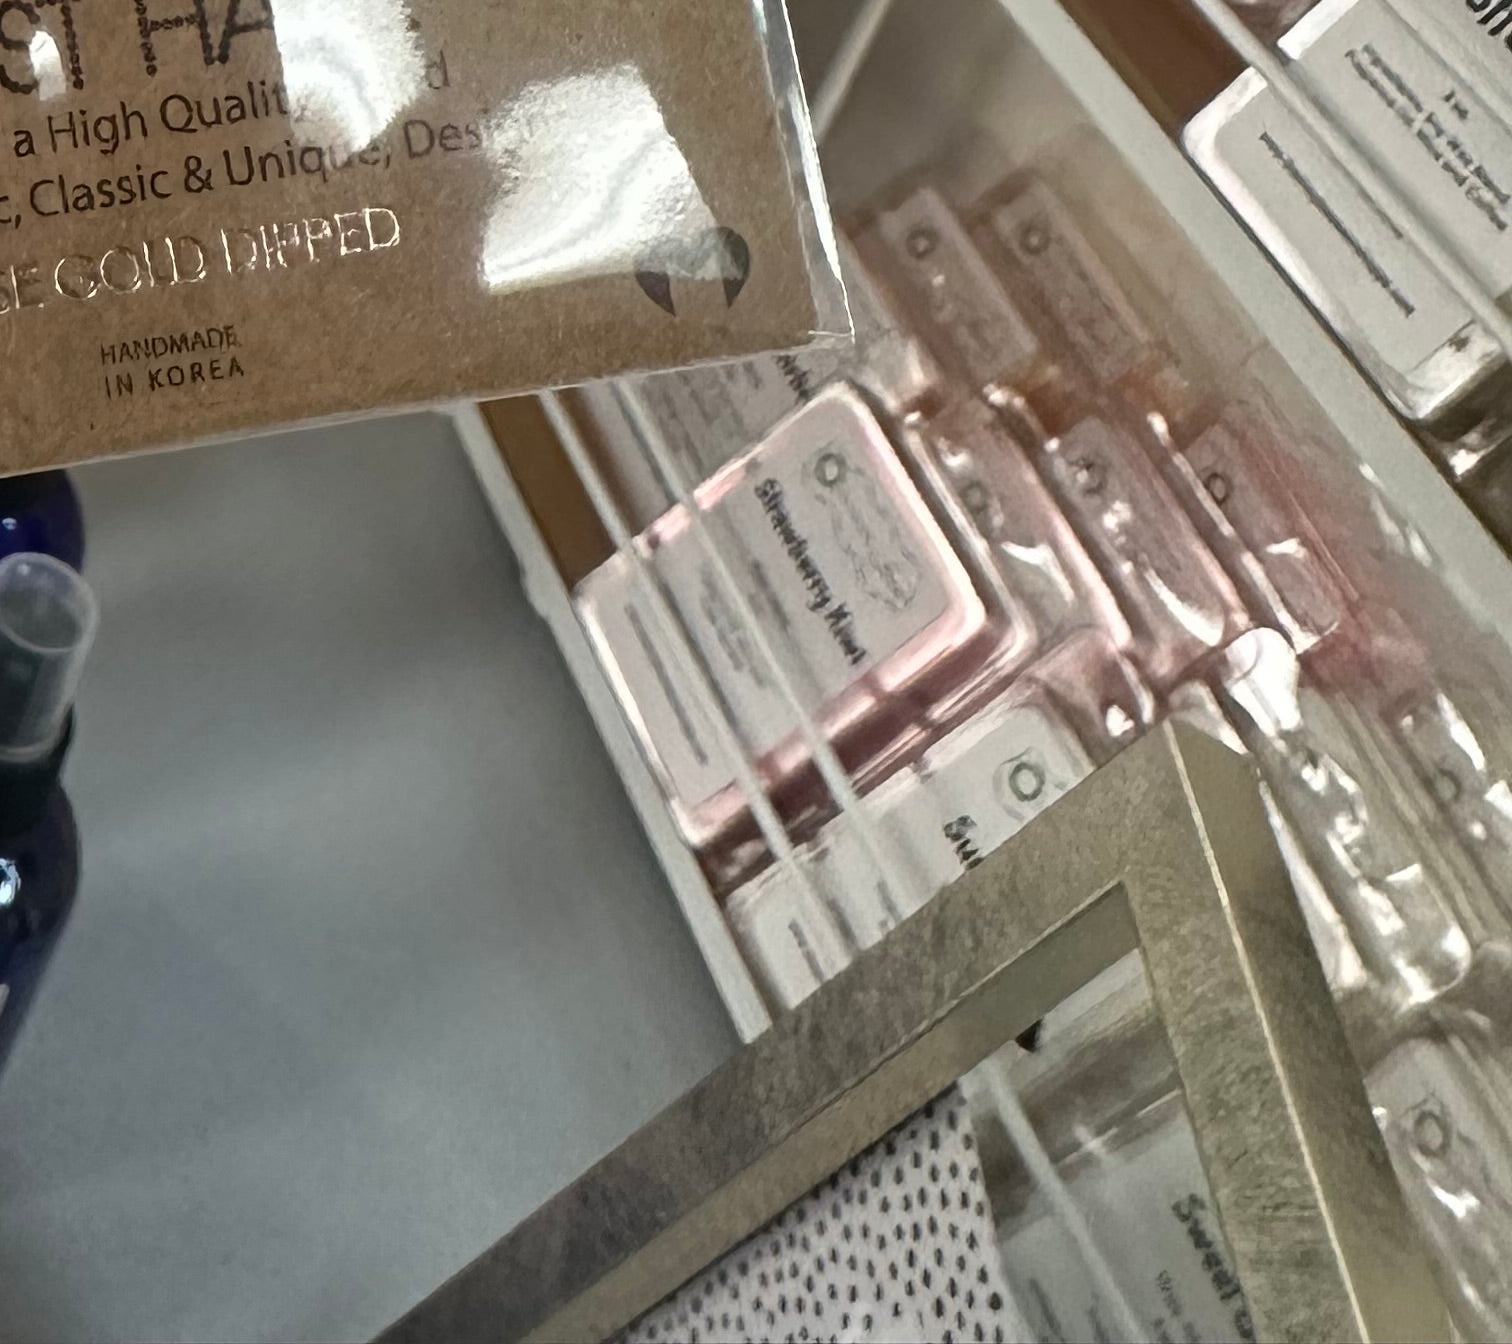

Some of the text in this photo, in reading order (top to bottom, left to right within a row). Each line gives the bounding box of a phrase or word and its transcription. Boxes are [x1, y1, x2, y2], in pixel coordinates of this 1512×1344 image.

[13, 129, 35, 158] a
[47, 101, 149, 156] High
[159, 78, 300, 135] Qualit
[29, 166, 172, 217] Classic
[184, 155, 215, 195] &
[54, 234, 208, 300] GOLD
[220, 206, 402, 274] DIPPED
[100, 323, 242, 367] HANDMADE
[103, 356, 246, 399] IN KOREA
